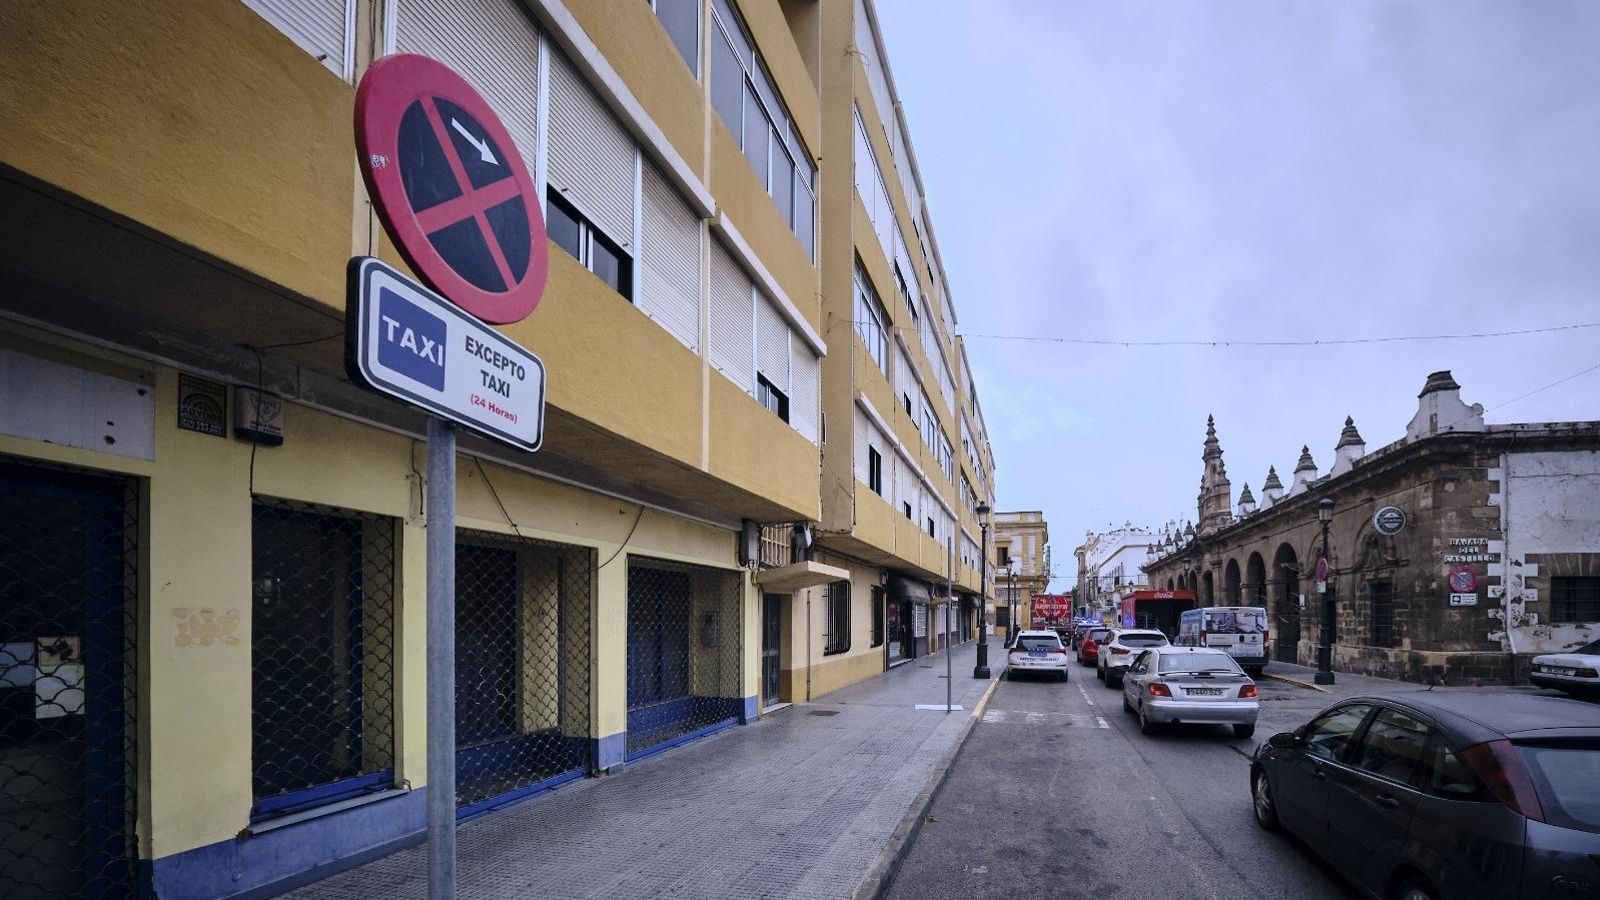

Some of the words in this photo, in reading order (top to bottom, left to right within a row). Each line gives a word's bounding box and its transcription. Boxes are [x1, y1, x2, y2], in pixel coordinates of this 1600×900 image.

[382, 314, 444, 367] TAXI
[465, 335, 526, 381] EXCEPTO
[480, 369, 511, 398] TAXI
[470, 393, 486, 408] (24
[488, 401, 518, 424] Horas)
